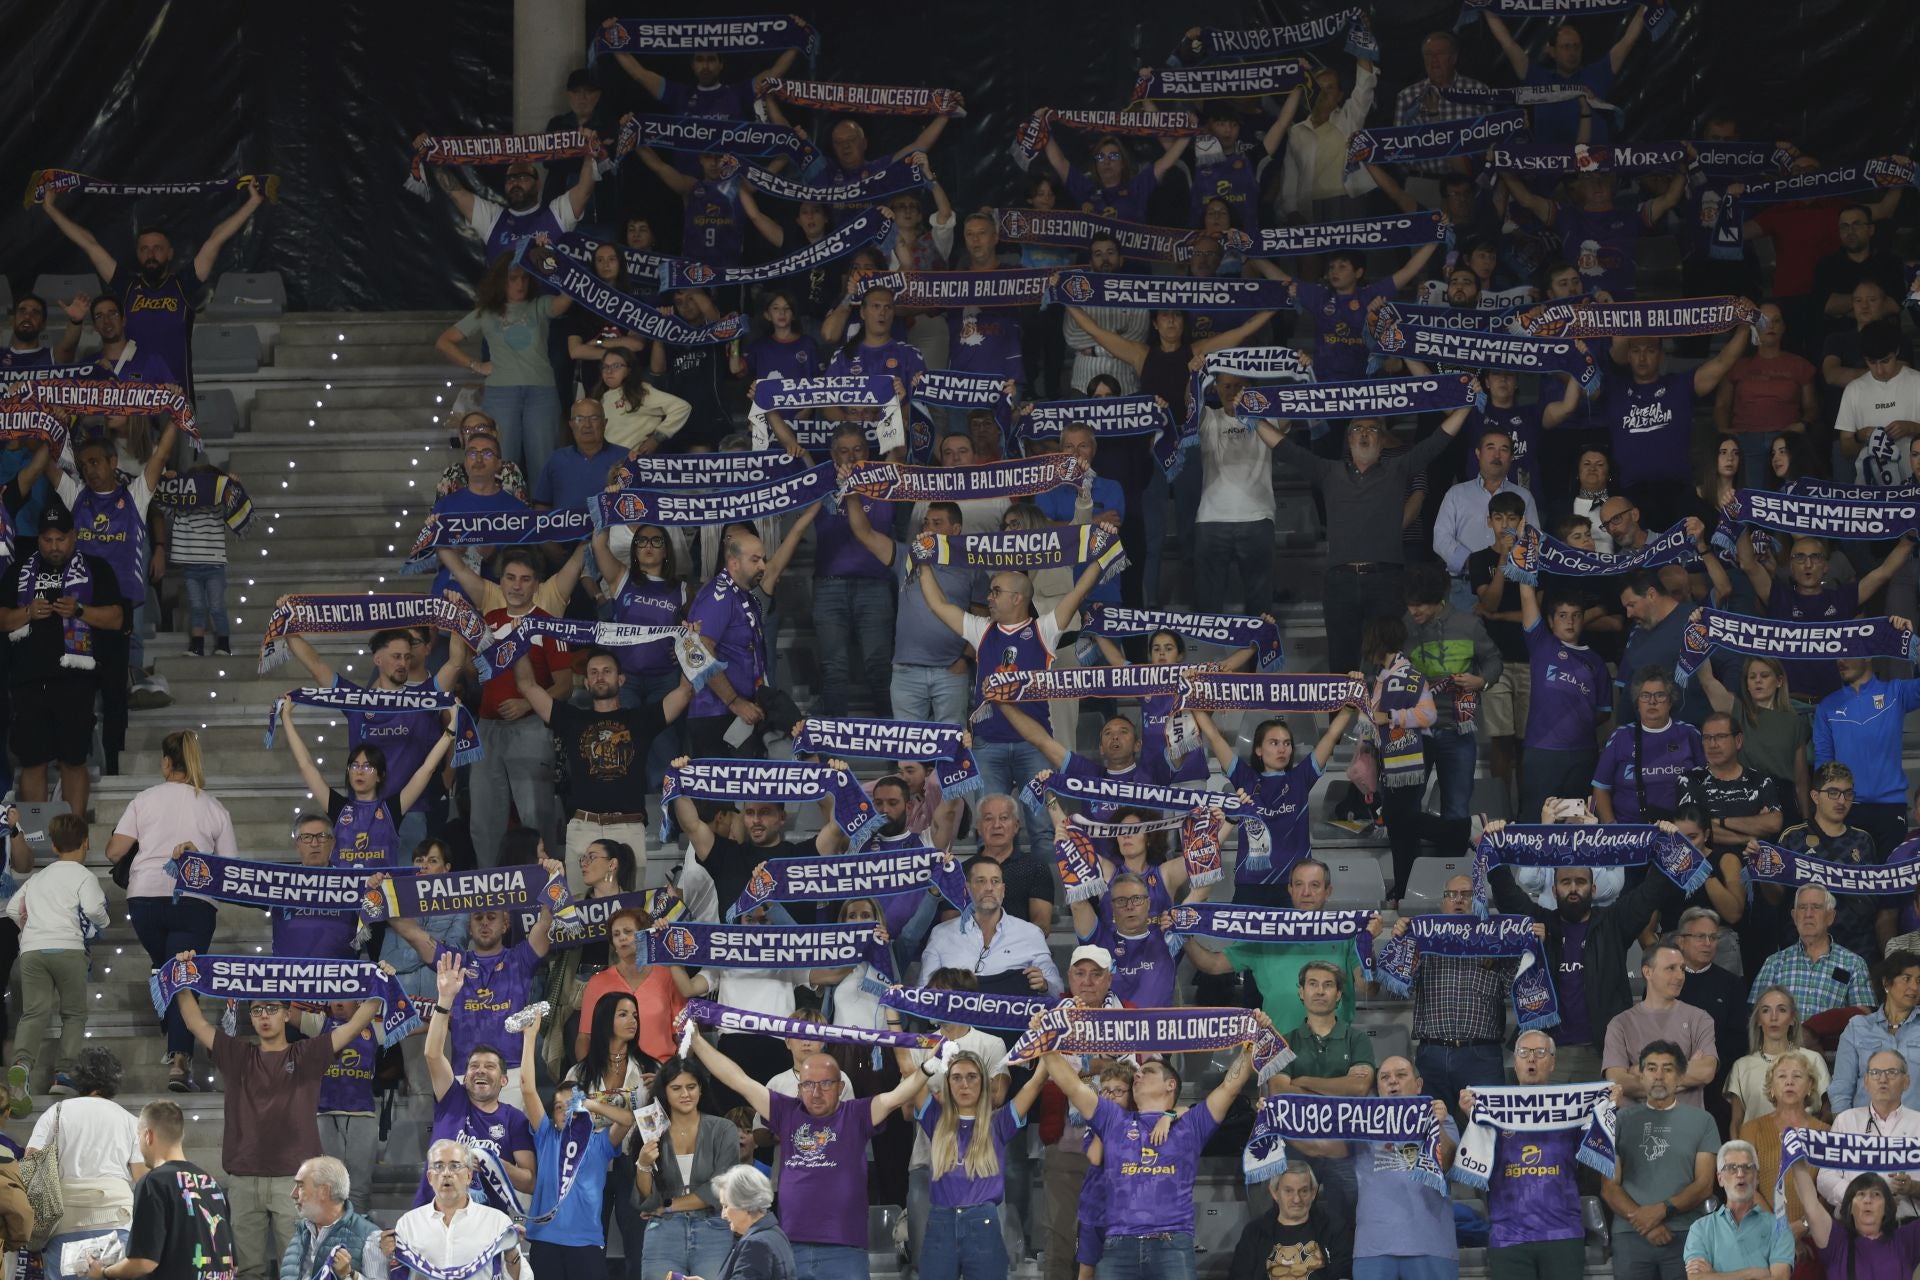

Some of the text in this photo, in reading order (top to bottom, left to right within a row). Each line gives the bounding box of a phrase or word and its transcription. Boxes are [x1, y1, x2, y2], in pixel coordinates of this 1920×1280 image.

[639, 20, 788, 36] SENTIMIENTO
[639, 35, 765, 49] PALENTINO.
[1161, 64, 1299, 82] SENTIMIENTO
[786, 80, 929, 105] PALENCIA BALONCESTO
[1162, 78, 1280, 94] PALENTINO.
[442, 131, 586, 157] PALENCIA BALONCESTO
[644, 120, 801, 151] zunder palencia
[1381, 117, 1524, 151] zunder palenc
[1696, 149, 1765, 166] alencia
[1775, 167, 1857, 194] palencia
[705, 227, 716, 247] 9
[1260, 219, 1412, 239] SENTIMIENTO
[724, 216, 867, 273] SENTIMIENTO
[1263, 232, 1387, 251] PALENTINO.
[725, 241, 851, 281] PALENTINO.
[909, 276, 1051, 299] PALENCIA BALONCEST
[1103, 279, 1260, 293] SENTIMIENTO
[1104, 292, 1236, 304] PALENTINO.
[1406, 313, 1483, 329] zunder
[1579, 305, 1735, 329] PALENCIA BALONCESTO
[1415, 331, 1570, 355] SENTIMIENTO
[1414, 342, 1543, 367] PALENTINO.
[0, 365, 94, 380] IMIENTO
[781, 375, 870, 391] BASKET
[919, 374, 1005, 391] NTIMIEN
[37, 386, 184, 411] PALENCIA BALONCESTO
[773, 390, 879, 407] PALENCIA
[914, 385, 1001, 403] LENTINO
[1277, 379, 1439, 401] SENTIMIENTO
[1029, 401, 1162, 420] SENTIMIEN
[1281, 395, 1415, 414] PALENTINO.
[1629, 404, 1663, 419] JUEGA
[0, 410, 65, 442] ALONCESTO
[1033, 415, 1159, 434] PALNTINO.
[637, 454, 793, 471] SENTIMIENTO
[640, 469, 770, 484] PALENTINO.
[902, 464, 1055, 491] PALENCIA BALONCESTO
[657, 473, 818, 509] SENTIMIENTO
[1806, 485, 1881, 501] zunder
[658, 498, 797, 521] PALENTINO.
[1750, 495, 1916, 520] SENTIMIENTO
[448, 512, 529, 532] zunder
[1751, 508, 1890, 534] PALENTINO.
[965, 532, 1061, 553] PALENCIA
[968, 551, 1062, 566] BALONCESTO
[1539, 543, 1600, 573] under
[296, 598, 456, 623] PALENCIA BALONCESTO
[634, 595, 677, 613] zunder
[1103, 607, 1264, 630] SENTIMIENTO
[1708, 615, 1875, 638] SENTIMIENTO
[517, 620, 577, 641] PALENCIA
[616, 626, 644, 636] REAL
[1708, 628, 1849, 654] PALENTINO.
[1900, 628, 1911, 656] acb
[1036, 667, 1106, 690] PALENCIA
[1195, 681, 1364, 702] PALENCIA BALONCESTO
[369, 725, 410, 737] zunde
[805, 719, 965, 741] SENTIMIENTO
[809, 732, 943, 755] PALENTINO.
[943, 769, 968, 786] acb
[1641, 763, 1686, 776] zunder
[679, 776, 825, 796] PALENTINO.
[1065, 777, 1241, 810] SENTIMIENTO
[847, 812, 868, 831] acb
[1548, 826, 1570, 847] mi
[339, 850, 385, 867] agropal
[223, 865, 371, 889] SENTIMIENT
[416, 870, 526, 899] PALENCIA
[222, 879, 365, 904] PALENTINO.
[419, 890, 528, 912] BALONCESTO
[1212, 919, 1363, 937] PALENTINO.
[1476, 917, 1497, 936] mi
[709, 946, 863, 963] PALENTINO.
[212, 961, 389, 982] SENTIMIENTO
[211, 976, 367, 993] PALENTINO.
[889, 987, 1046, 1013] nder palencia
[385, 1010, 406, 1031] acb
[1075, 1013, 1257, 1042] PALENCIA BALONCESTO
[1784, 1127, 1920, 1149] SENTIMIEN
[1120, 1164, 1176, 1176] agropal
[1504, 1164, 1560, 1178] agropal
